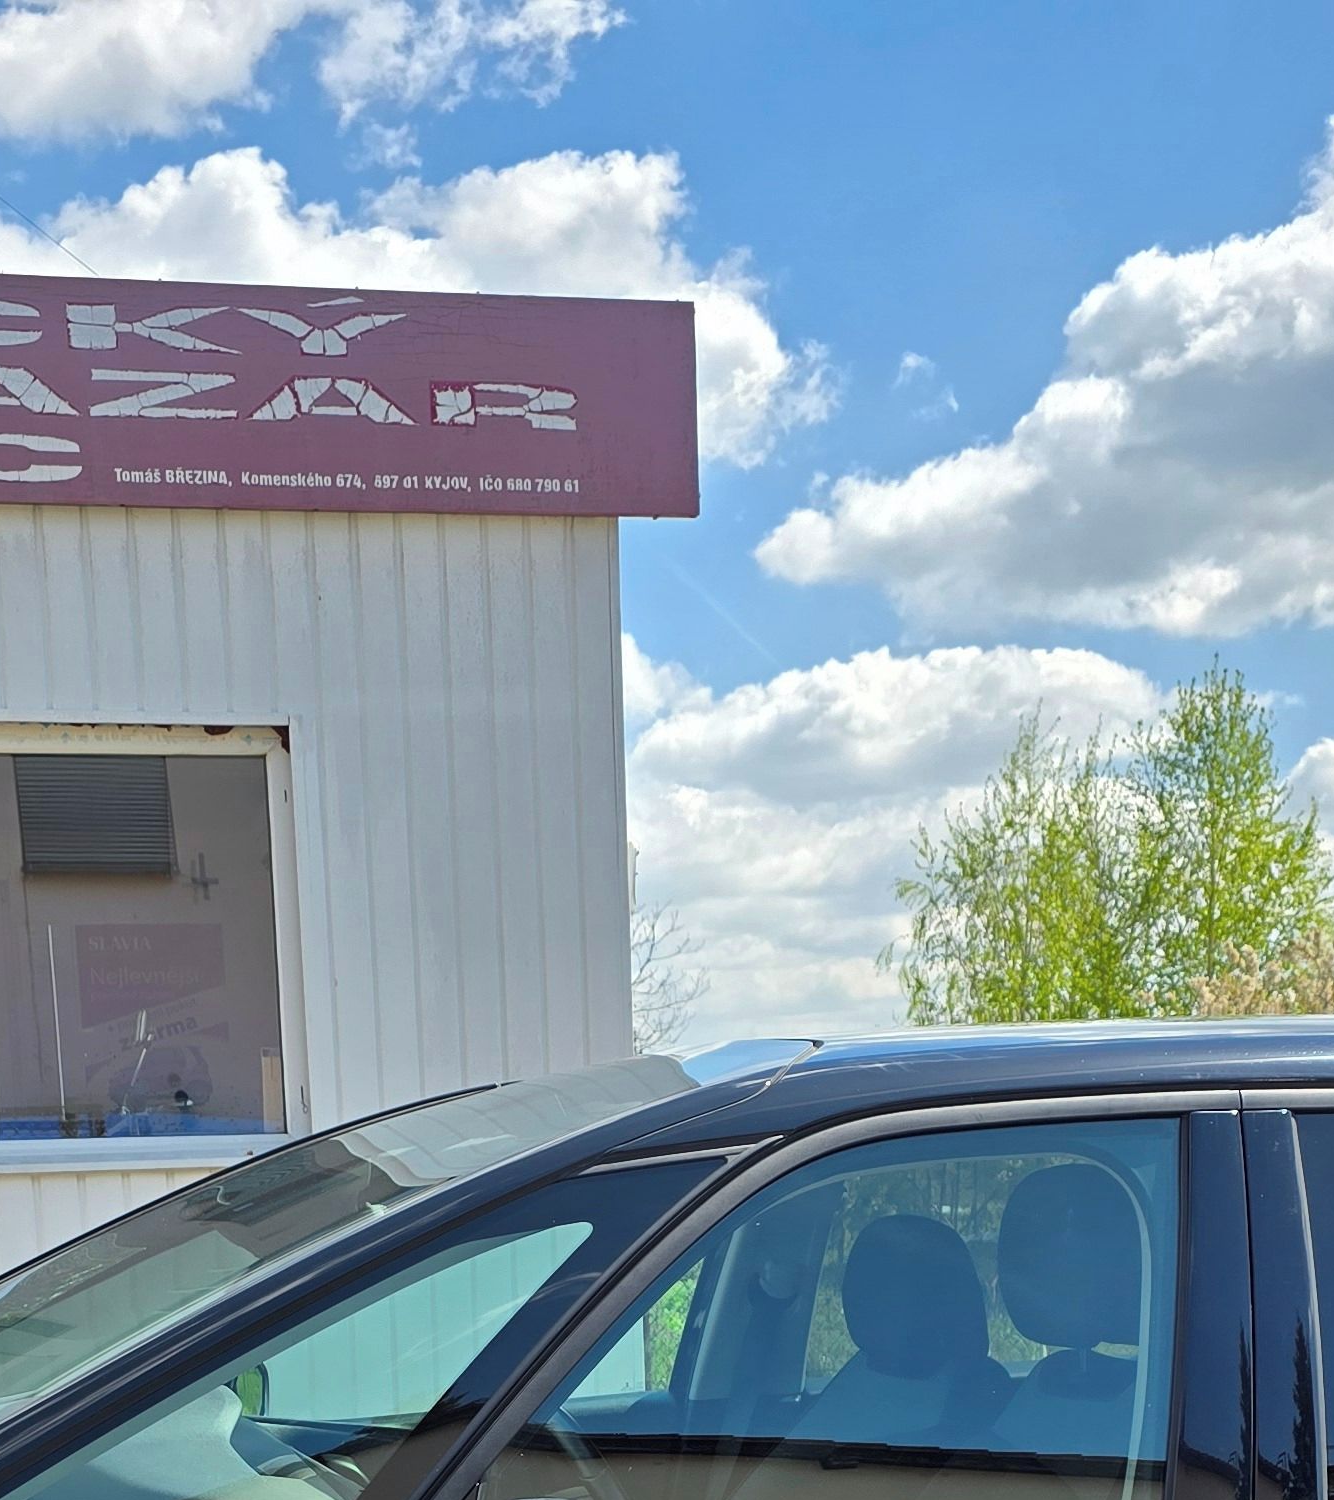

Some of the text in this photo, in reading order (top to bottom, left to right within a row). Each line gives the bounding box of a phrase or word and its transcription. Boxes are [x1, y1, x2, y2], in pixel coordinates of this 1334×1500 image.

[114, 468, 162, 484] Tomáš
[166, 467, 233, 487] BŘEZINA,
[241, 471, 332, 487] Komenského
[336, 473, 366, 490] 674,
[403, 475, 419, 489] 01
[424, 475, 472, 492] KYJOV,
[479, 474, 503, 491] IČO
[536, 478, 561, 492] 790
[564, 479, 580, 493] 61
